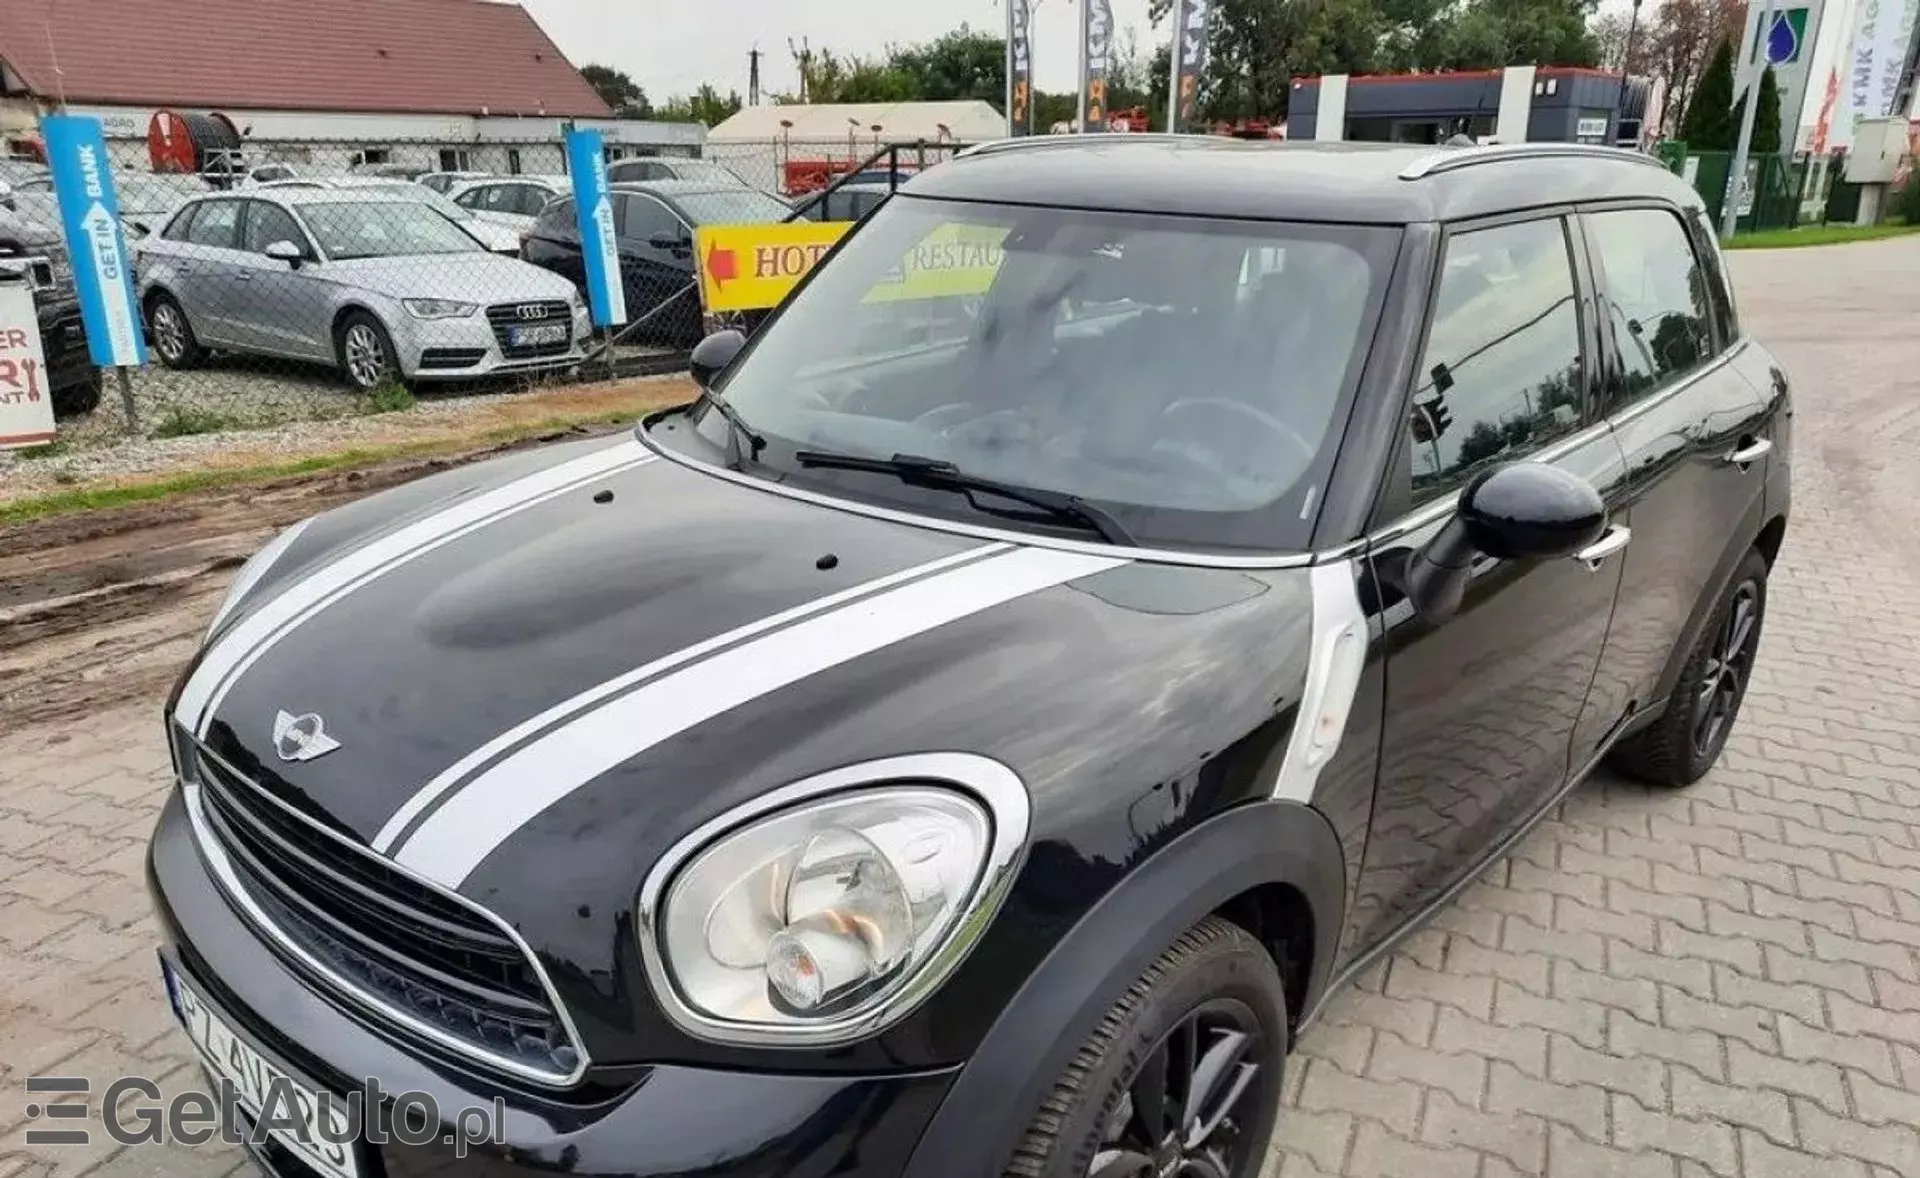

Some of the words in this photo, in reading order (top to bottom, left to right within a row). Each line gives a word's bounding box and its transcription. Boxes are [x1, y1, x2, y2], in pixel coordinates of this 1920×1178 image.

[77, 144, 103, 198] BANK
[93, 217, 108, 238] IN
[97, 243, 119, 280] GET
[755, 243, 833, 277] HOT
